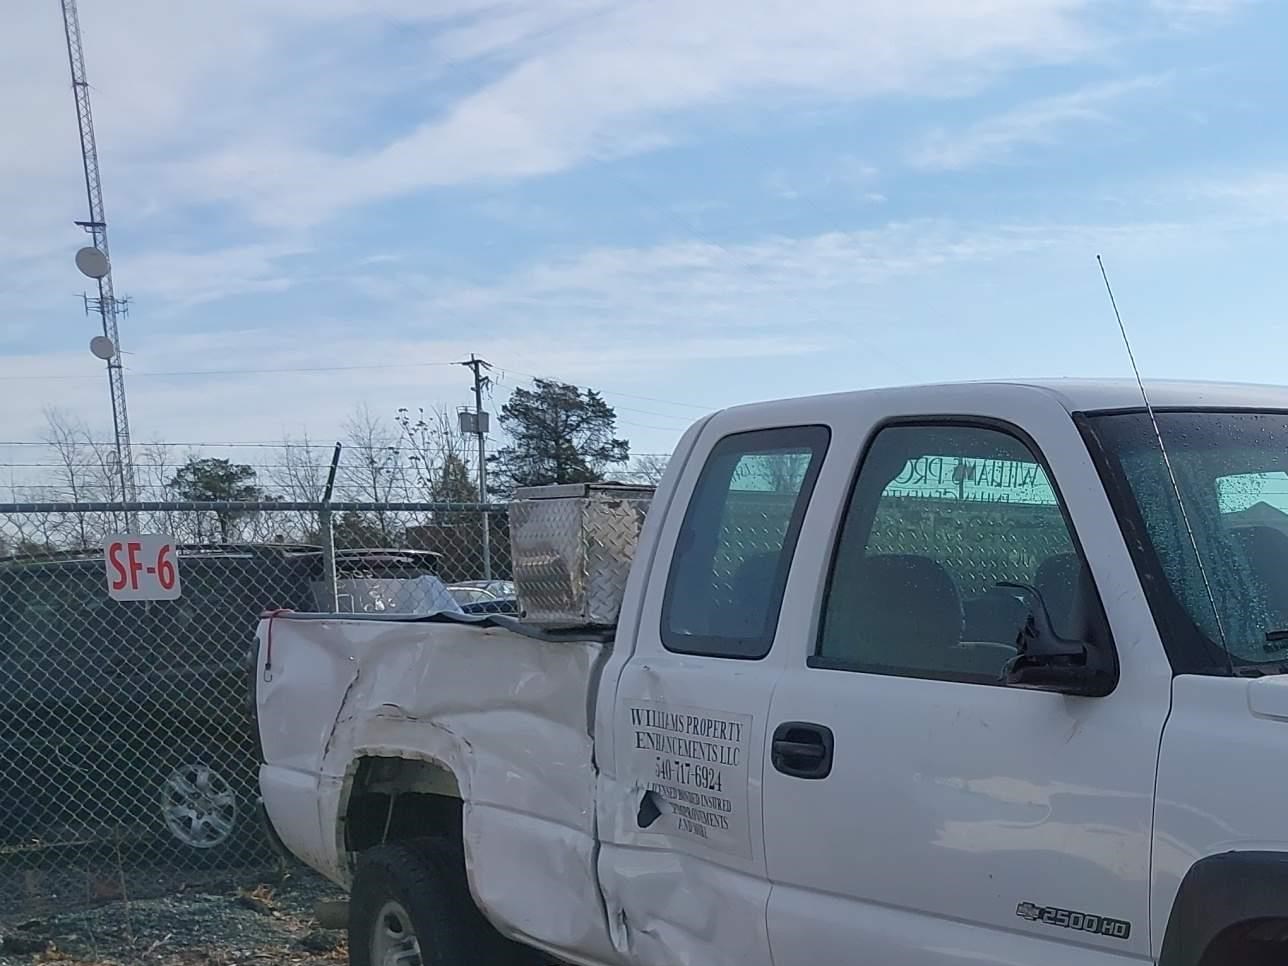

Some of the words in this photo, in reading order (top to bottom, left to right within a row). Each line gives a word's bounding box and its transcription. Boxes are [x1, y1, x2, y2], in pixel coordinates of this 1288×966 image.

[109, 543, 175, 590] SF-6
[631, 708, 684, 733] WILLIAMS
[686, 715, 744, 742] PROPERTY
[720, 746, 740, 766] LLC
[701, 794, 732, 813] INSURED
[1042, 907, 1098, 933] 2500
